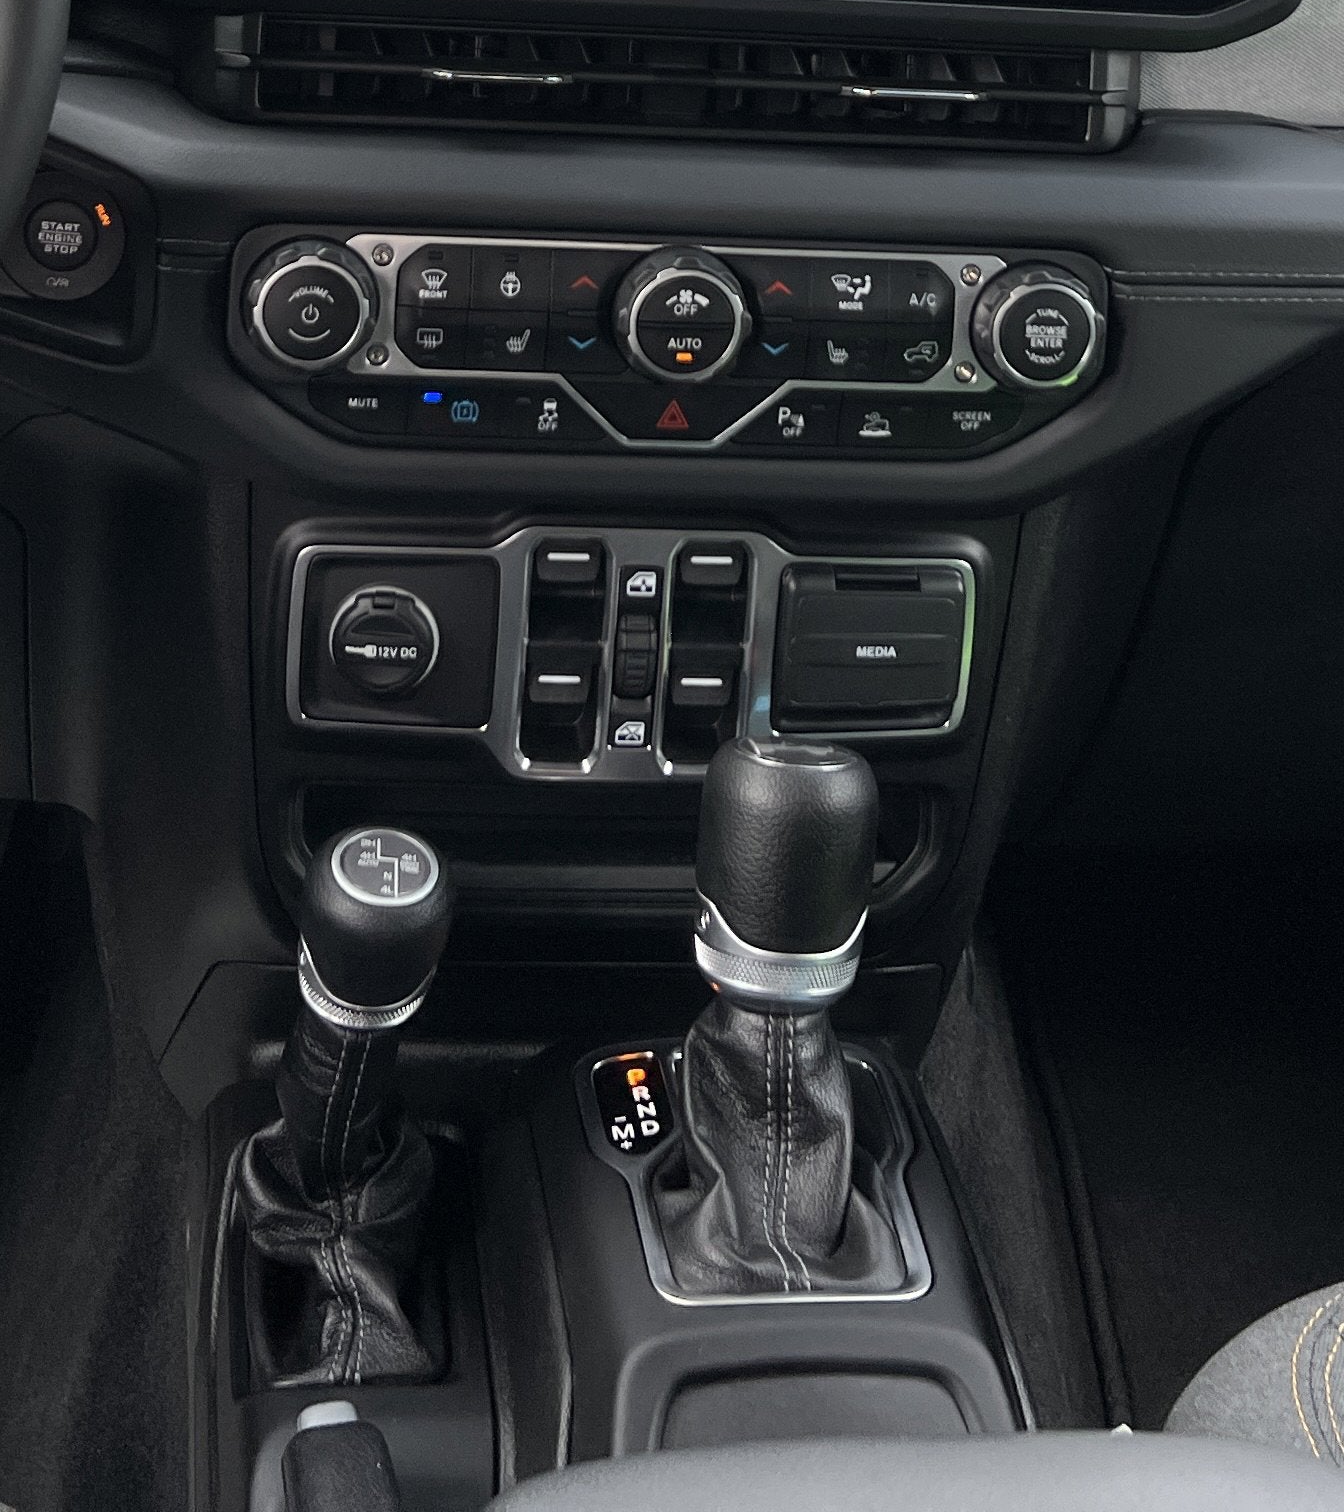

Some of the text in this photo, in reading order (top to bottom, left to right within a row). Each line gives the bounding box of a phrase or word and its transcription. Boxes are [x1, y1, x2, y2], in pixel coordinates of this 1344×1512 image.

[41, 220, 81, 232] START
[37, 231, 83, 245] ENGINE
[43, 243, 78, 255] STOP
[295, 285, 330, 299] VOLUME
[418, 288, 448, 299] FRONT
[838, 300, 864, 311] MODE
[908, 291, 937, 307] A/C
[673, 303, 699, 316] OFF
[1036, 307, 1061, 319] TUNE
[1024, 324, 1068, 337] BROWSE
[667, 336, 703, 350] AUTO
[1029, 336, 1064, 349] ENTER
[1027, 352, 1062, 365] SCROLL
[347, 397, 379, 410] MUTE
[952, 410, 992, 422] SCREEN
[537, 419, 558, 432] OFF
[782, 426, 803, 438] OFF
[960, 420, 980, 431] OFF
[377, 646, 398, 659] 12V
[855, 645, 897, 658] MEDIA
[383, 870, 393, 882] N
[380, 884, 393, 896] 4L
[626, 1068, 647, 1086] P
[632, 1085, 651, 1102] R
[636, 1101, 657, 1119] N
[611, 1122, 636, 1141] M
[640, 1119, 661, 1137] D
